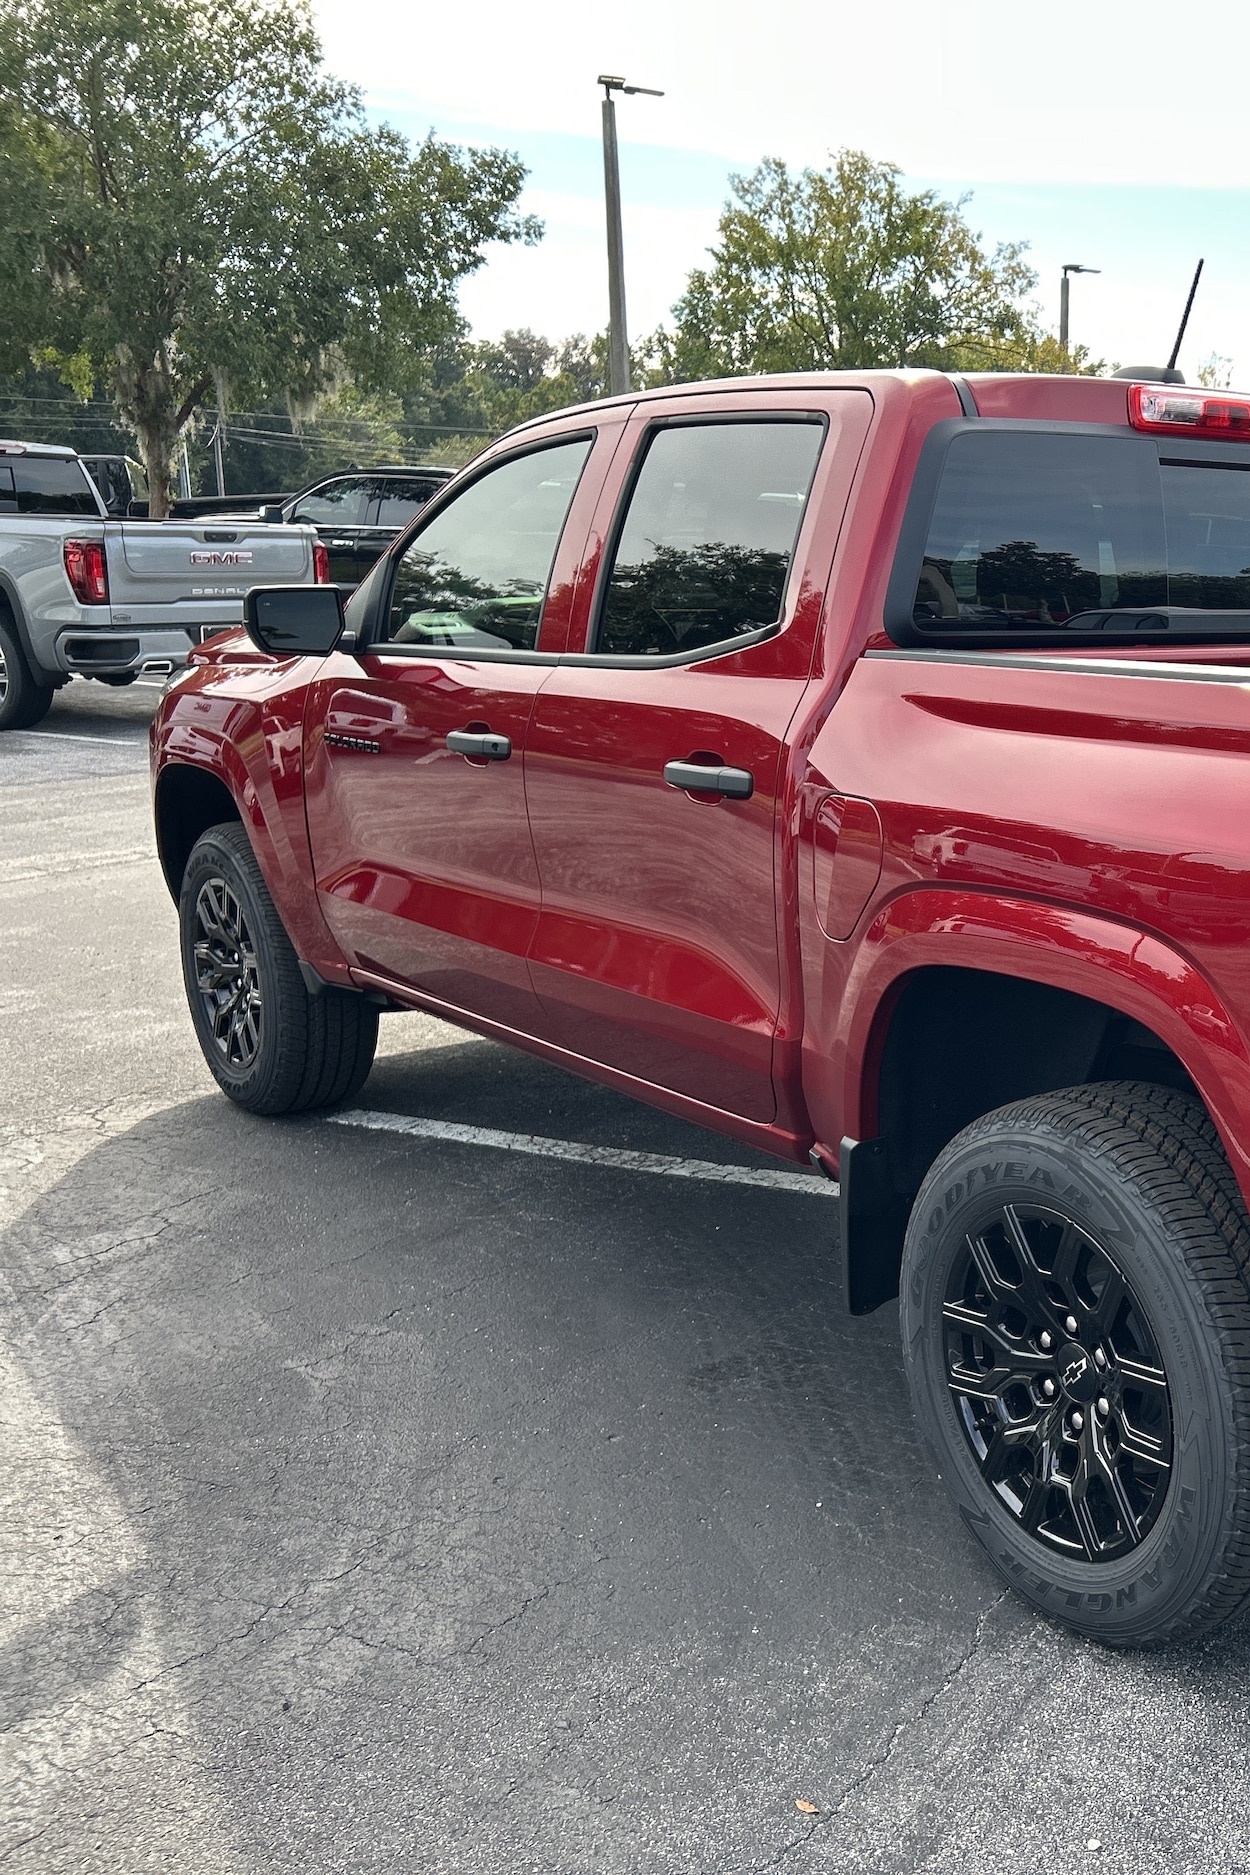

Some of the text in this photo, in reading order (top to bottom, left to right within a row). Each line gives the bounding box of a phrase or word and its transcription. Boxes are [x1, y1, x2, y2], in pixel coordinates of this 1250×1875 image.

[190, 551, 253, 566] GMC
[912, 1160, 1093, 1310] GOODYEAR
[999, 1484, 1198, 1615] WRANGLER
